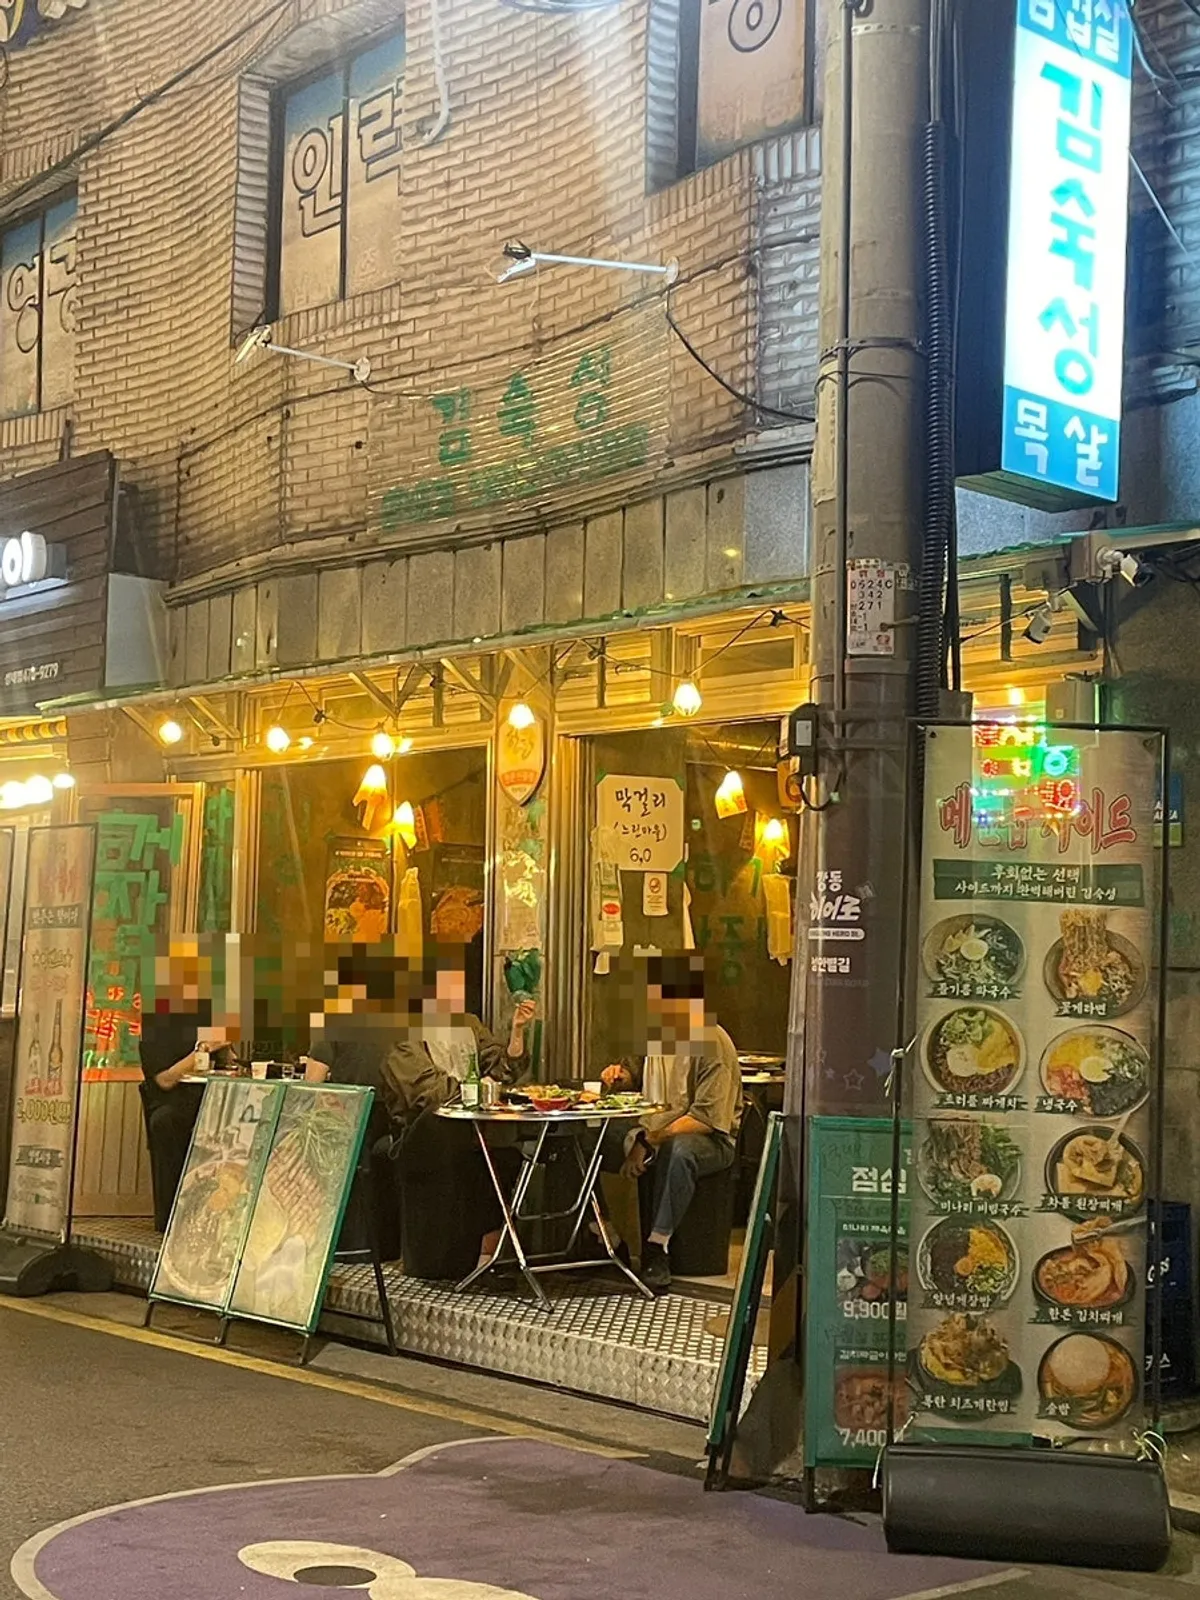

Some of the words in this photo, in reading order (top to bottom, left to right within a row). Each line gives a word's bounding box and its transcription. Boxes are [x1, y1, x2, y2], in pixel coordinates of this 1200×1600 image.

[1014, 398, 1108, 488] 목살
[615, 787, 666, 817] 막걸리
[1052, 866, 1080, 883] 선택
[939, 1199, 973, 1213] 미나리
